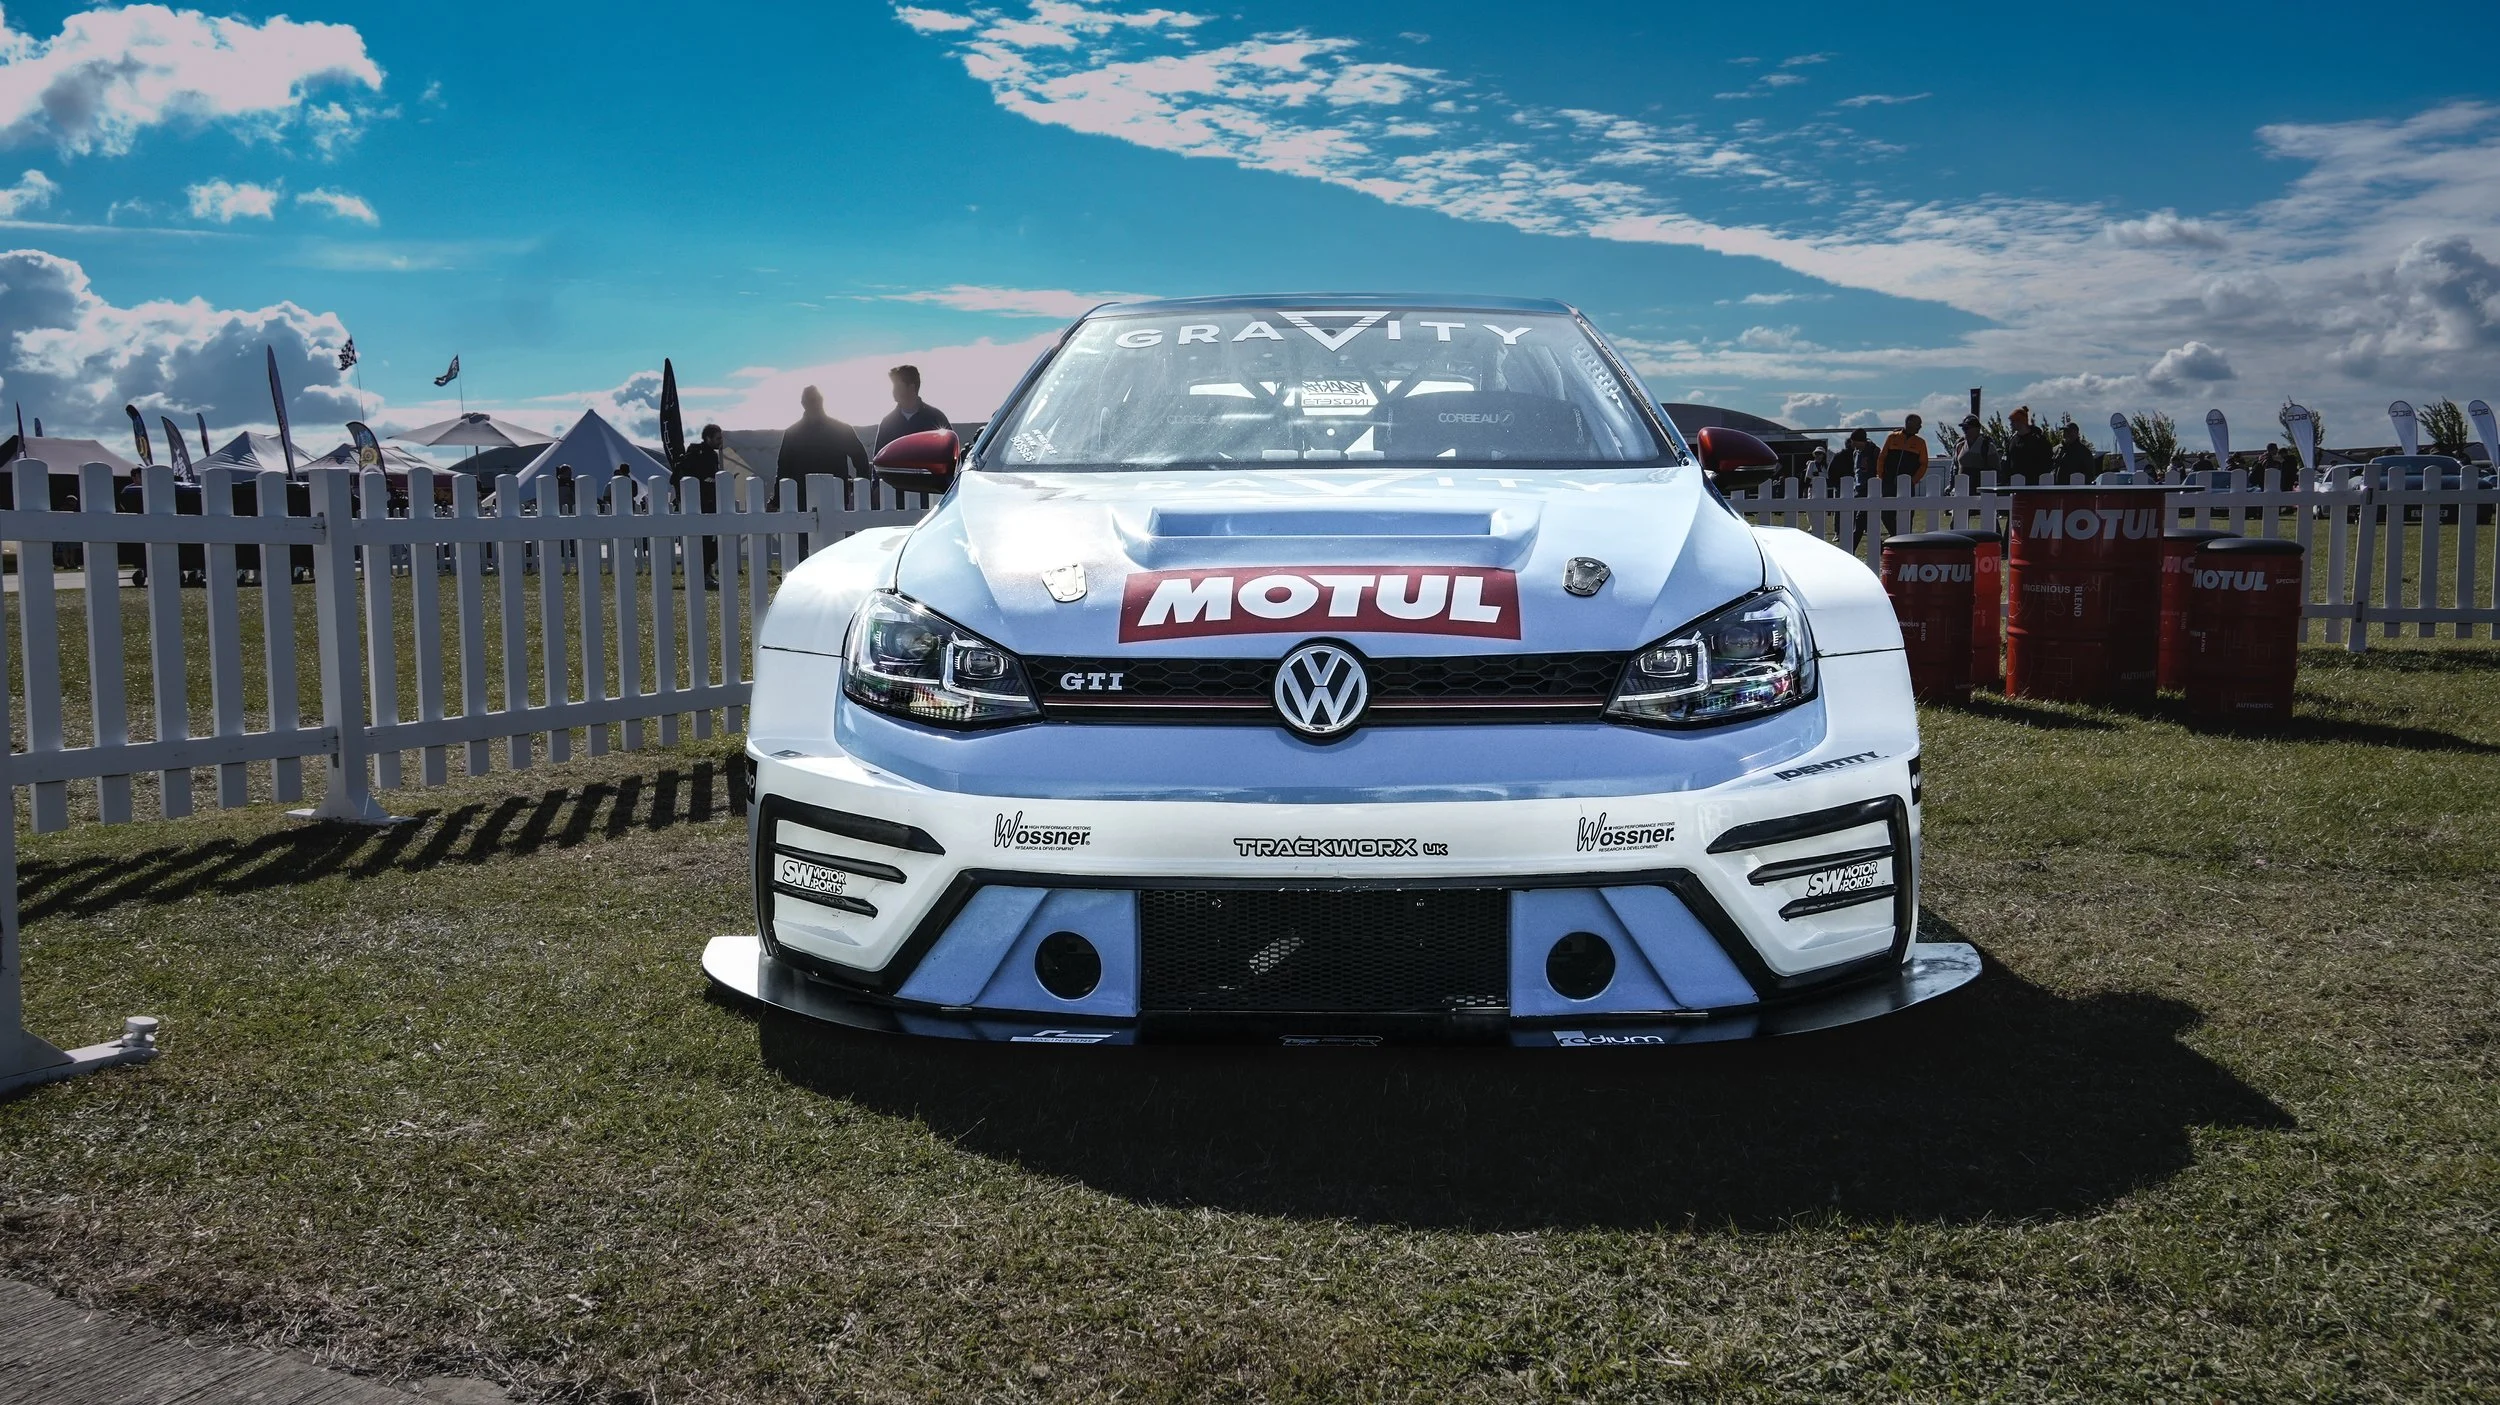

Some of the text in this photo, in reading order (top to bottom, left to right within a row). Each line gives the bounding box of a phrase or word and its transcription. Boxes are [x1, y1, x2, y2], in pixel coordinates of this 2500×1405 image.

[1115, 311, 1532, 352] GRAVITY
[1438, 413, 1499, 423] CORBEAU
[2029, 509, 2158, 540] MOTUL
[1898, 564, 1972, 583] MOTUL
[2192, 568, 2268, 591] MOTUL
[1137, 574, 1502, 627] MOTUL
[2074, 586, 2083, 617] BLEND
[1060, 673, 1124, 690] GTI
[1774, 751, 1879, 781] IDENTITY
[1233, 838, 1448, 856] TRACKWORX UK
[813, 867, 846, 884] MOTOR
[1843, 861, 1877, 878] MOTOR
[1558, 1034, 1664, 1044] radium
